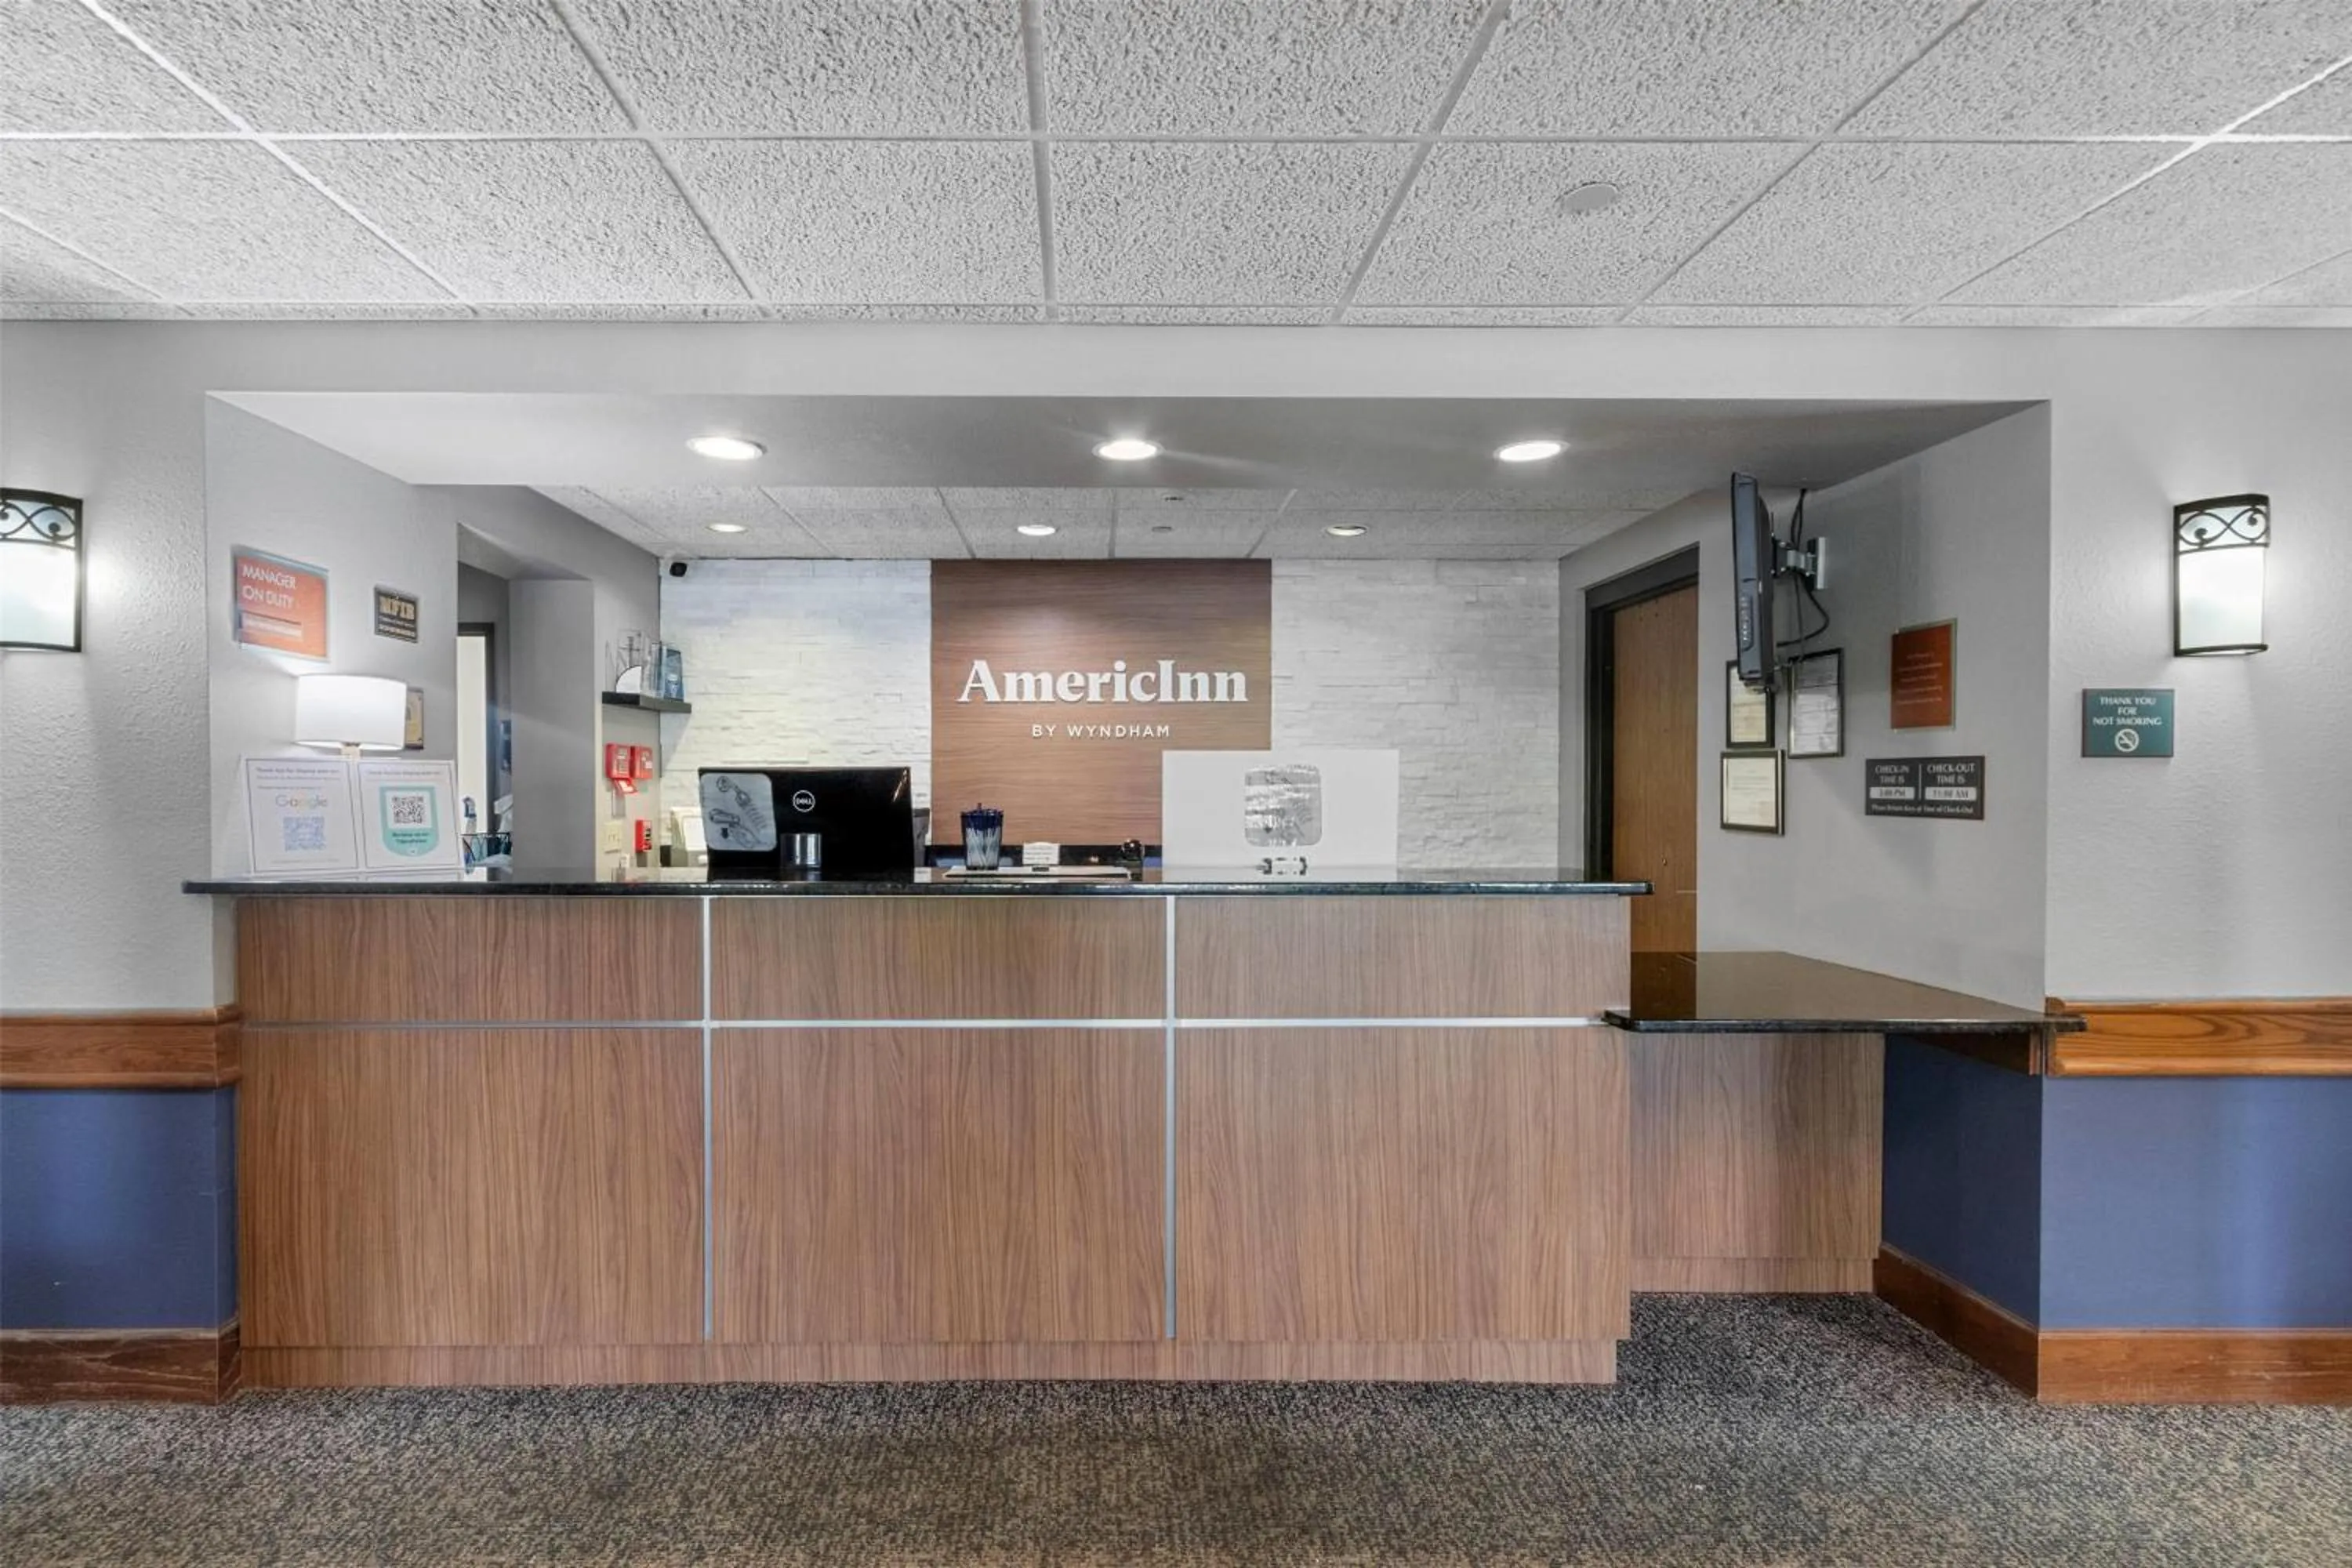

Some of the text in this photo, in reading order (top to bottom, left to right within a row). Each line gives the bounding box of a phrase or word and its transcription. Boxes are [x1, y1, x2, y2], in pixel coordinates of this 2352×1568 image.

[242, 564, 296, 590] MANAGER
[242, 585, 294, 609] ON DUTY
[955, 659, 1248, 703] AmericInn
[2100, 696, 2158, 705] THANK YOU
[2118, 706, 2137, 715] FOR
[2092, 717, 2162, 726] NOT SMOKING
[1032, 724, 1170, 738] BY WYNDHAM
[1926, 763, 1976, 774] CHECK-OUT
[796, 797, 813, 805] DELL
